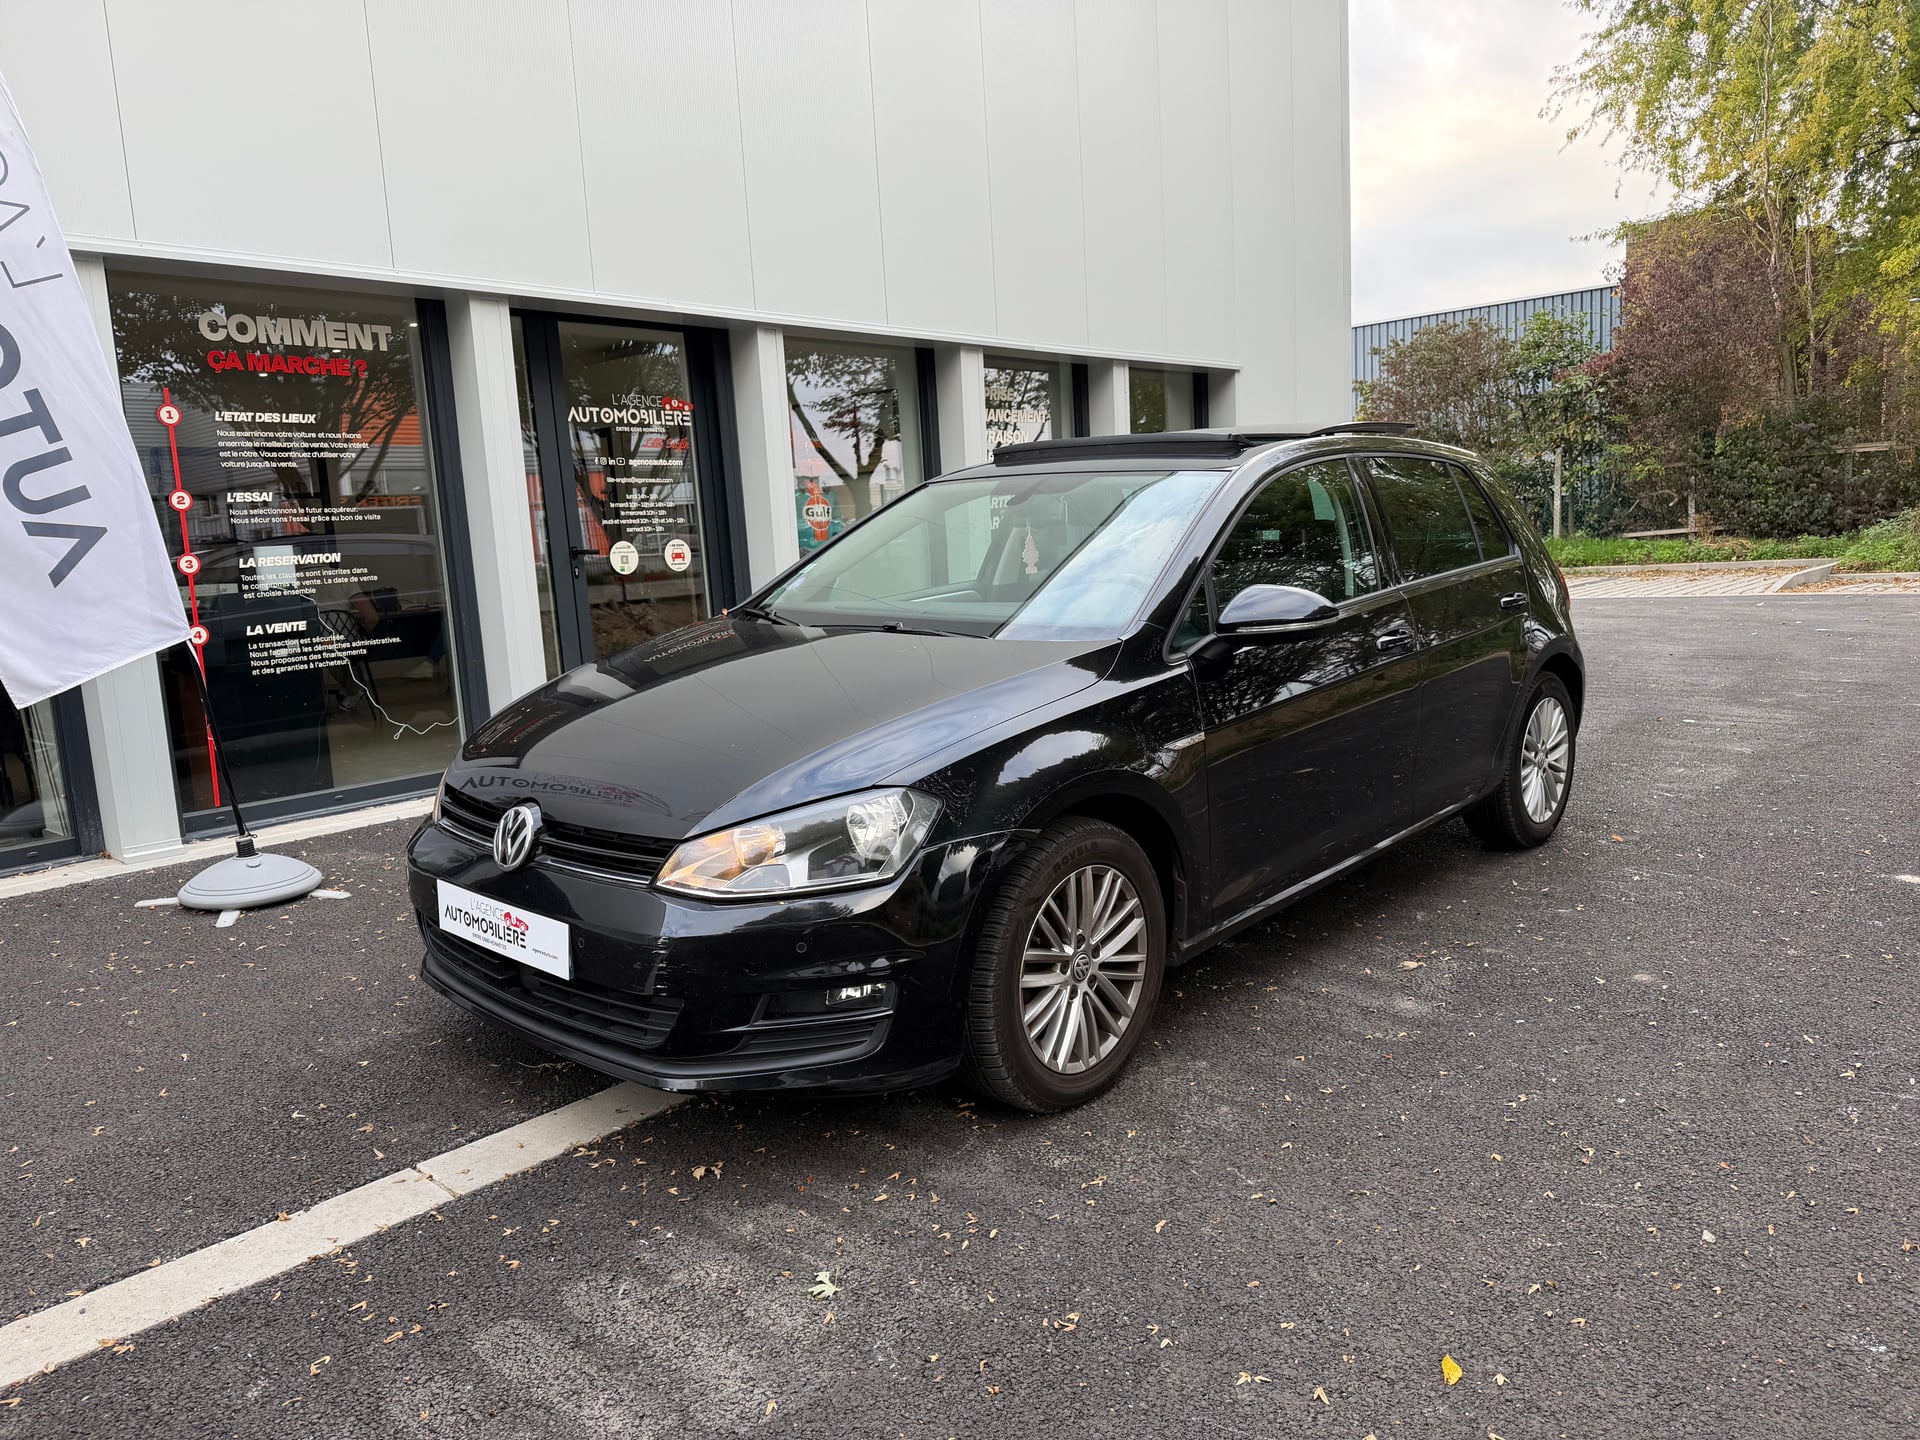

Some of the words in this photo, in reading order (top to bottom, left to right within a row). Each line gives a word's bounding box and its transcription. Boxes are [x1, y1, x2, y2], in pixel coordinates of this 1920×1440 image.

[198, 311, 392, 351] COMMENT
[207, 351, 244, 373] ÇA
[247, 352, 351, 376] MARCHE
[353, 359, 368, 377] ?
[611, 393, 663, 408] L'AGENCE
[214, 411, 254, 422] L'ETAT
[255, 412, 281, 423] DES
[282, 413, 316, 424] LIEUX
[216, 429, 236, 437] Nous
[236, 430, 274, 438] examinons
[253, 440, 260, 448] le
[259, 450, 278, 458] Vous
[278, 450, 312, 458] continuez
[226, 491, 273, 503] L'ESSAI
[310, 514, 330, 523] grâce
[805, 507, 831, 517] Gulf
[239, 557, 257, 569] LA
[257, 552, 342, 567] RESERVATION
[241, 573, 265, 582] Toutes
[278, 571, 304, 579] clauses
[321, 568, 351, 576] inscrites
[250, 580, 291, 591] compromis
[333, 576, 349, 584] date
[256, 590, 282, 598] choisie
[283, 587, 317, 596] ensemble
[246, 624, 264, 636] LA
[265, 620, 307, 634] VENTE
[258, 639, 299, 649] transaction
[300, 637, 311, 645] est
[302, 645, 312, 653] les
[313, 642, 350, 651] démarches
[351, 637, 402, 647] administratives.
[270, 655, 308, 666] proposons
[322, 648, 367, 658] financements
[252, 668, 260, 676] et
[261, 667, 275, 675] des
[275, 663, 308, 674] garanties
[470, 897, 505, 921] L'AGENCE
